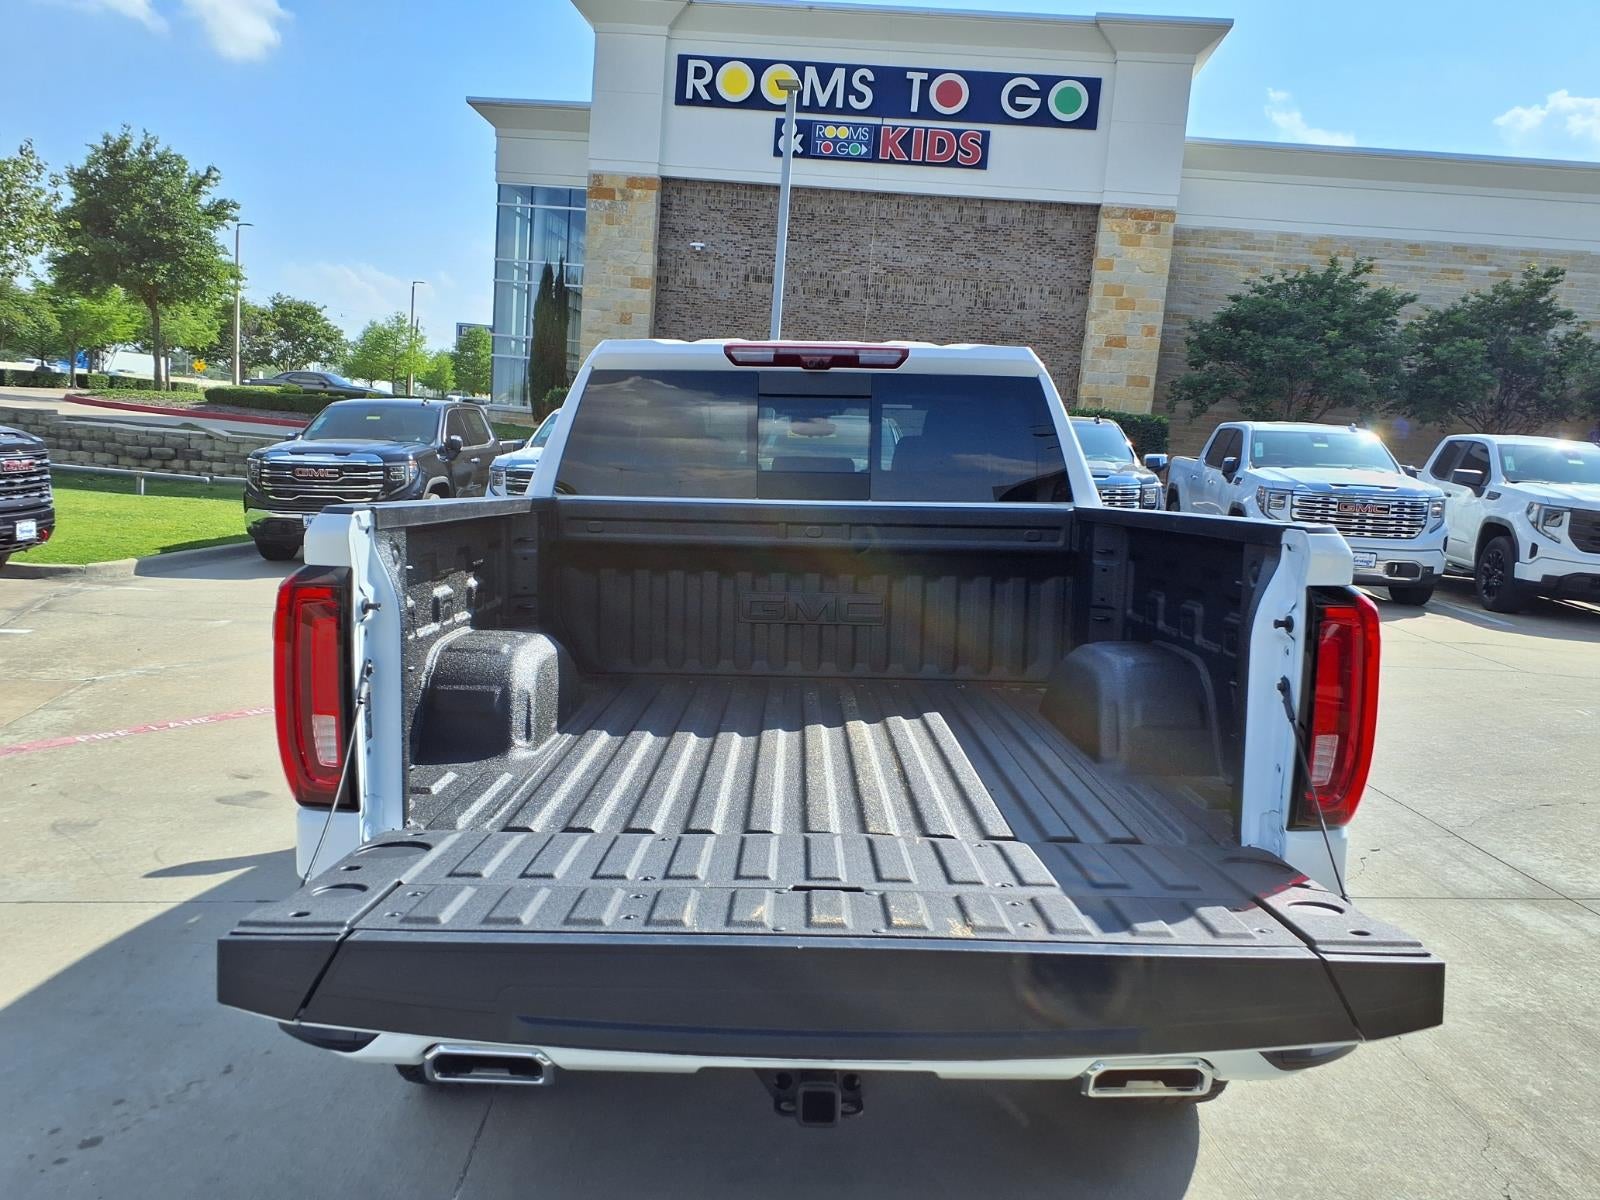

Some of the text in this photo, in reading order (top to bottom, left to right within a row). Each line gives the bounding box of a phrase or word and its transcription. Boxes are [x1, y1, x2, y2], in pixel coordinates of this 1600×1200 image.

[685, 58, 1089, 122] ROOMS TO GO
[815, 124, 869, 140] ROOMS
[815, 140, 861, 156] TO GO
[878, 125, 983, 166] KIDS
[294, 468, 339, 478] GMC
[1339, 502, 1390, 514] GMC
[741, 591, 885, 625] GMC
[76, 729, 135, 743] FIRE
